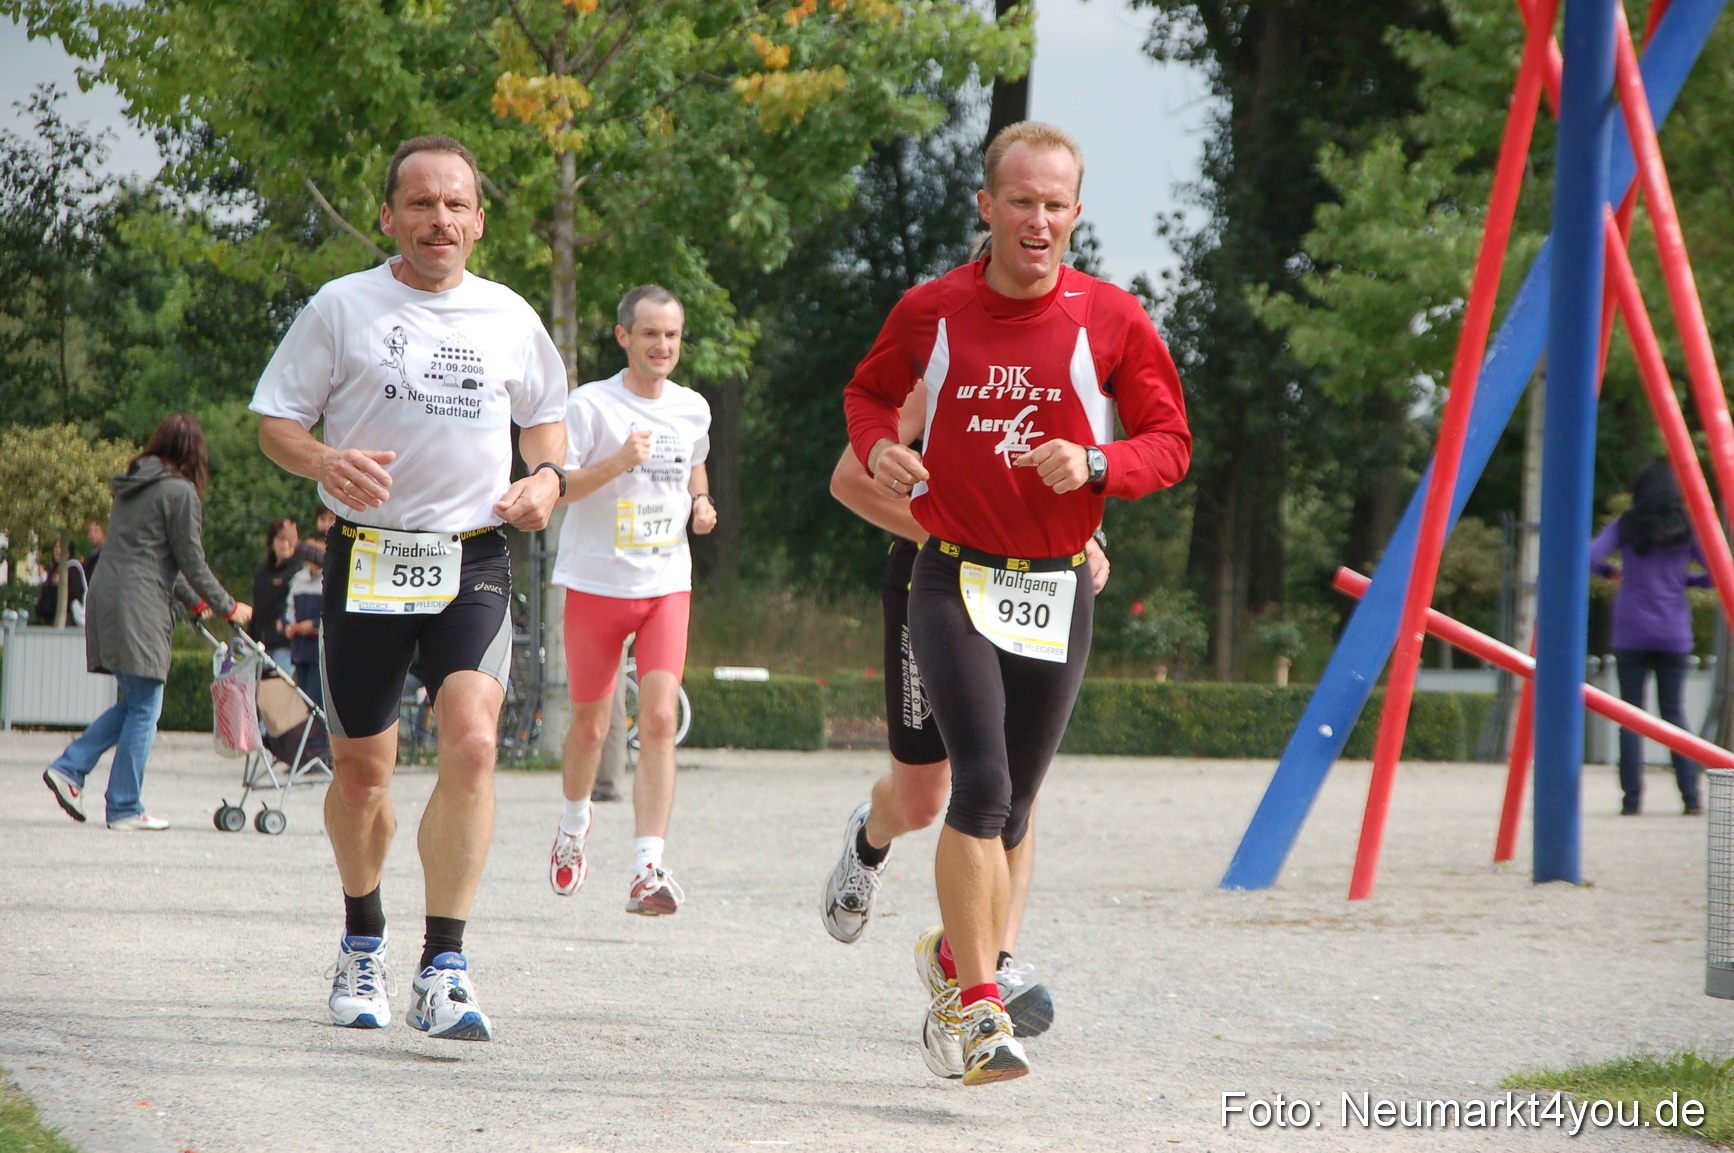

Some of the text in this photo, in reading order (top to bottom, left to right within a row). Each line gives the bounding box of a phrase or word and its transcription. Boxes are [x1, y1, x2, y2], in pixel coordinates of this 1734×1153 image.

[430, 361, 484, 375] 21.09.2008
[986, 365, 1034, 393] DJK
[407, 390, 482, 407] Neumarkter
[425, 404, 482, 419] Stadtlauf
[637, 504, 664, 515] Tobias
[643, 519, 672, 537] 377
[383, 539, 446, 557] Friedrich
[355, 559, 362, 571] A
[391, 564, 442, 588] 583
[993, 568, 1057, 596] Wolfgang
[998, 599, 1050, 628] 930
[901, 624, 910, 655] FRITZ
[901, 658, 912, 727] BUCHSTALLER
